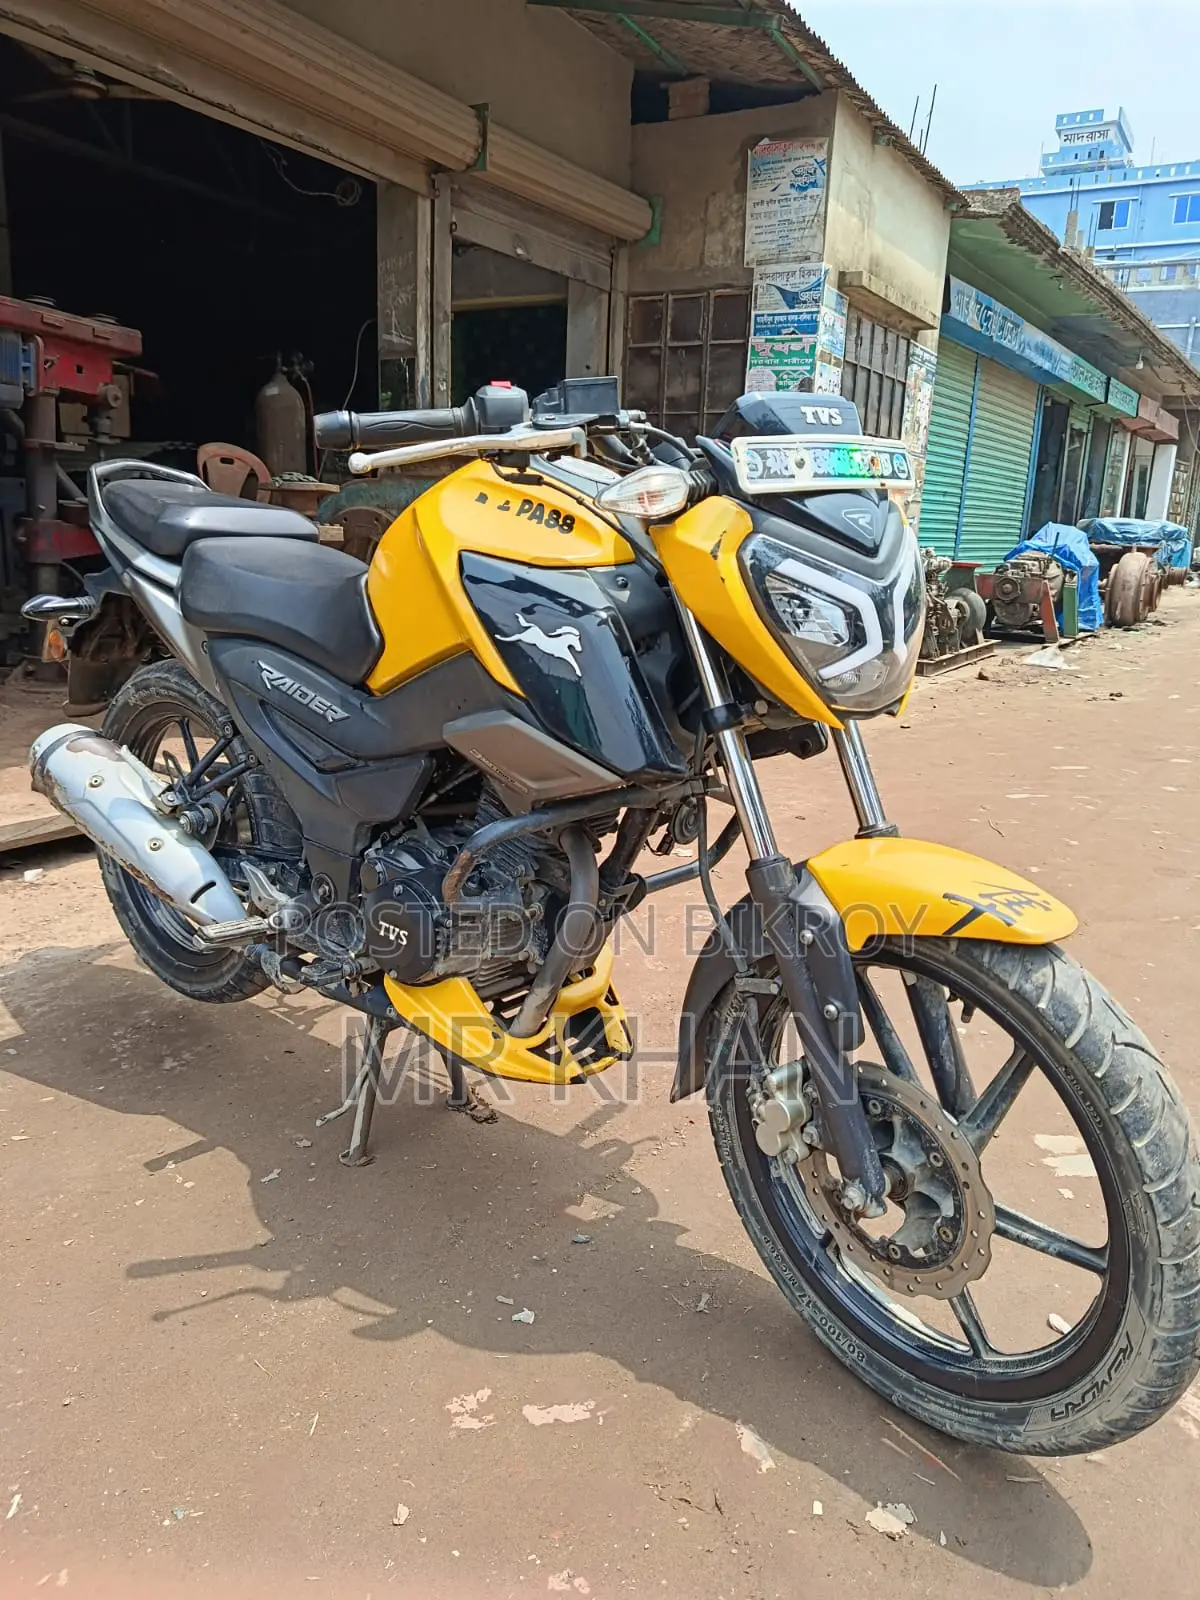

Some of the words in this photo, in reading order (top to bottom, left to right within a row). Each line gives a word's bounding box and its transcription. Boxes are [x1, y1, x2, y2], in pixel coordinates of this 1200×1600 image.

[1063, 129, 1110, 144] মাদরাসা
[800, 405, 843, 426] TVS
[257, 660, 351, 722] RAIDER
[379, 920, 409, 946] TVS
[1050, 1331, 1133, 1421] REMORA
